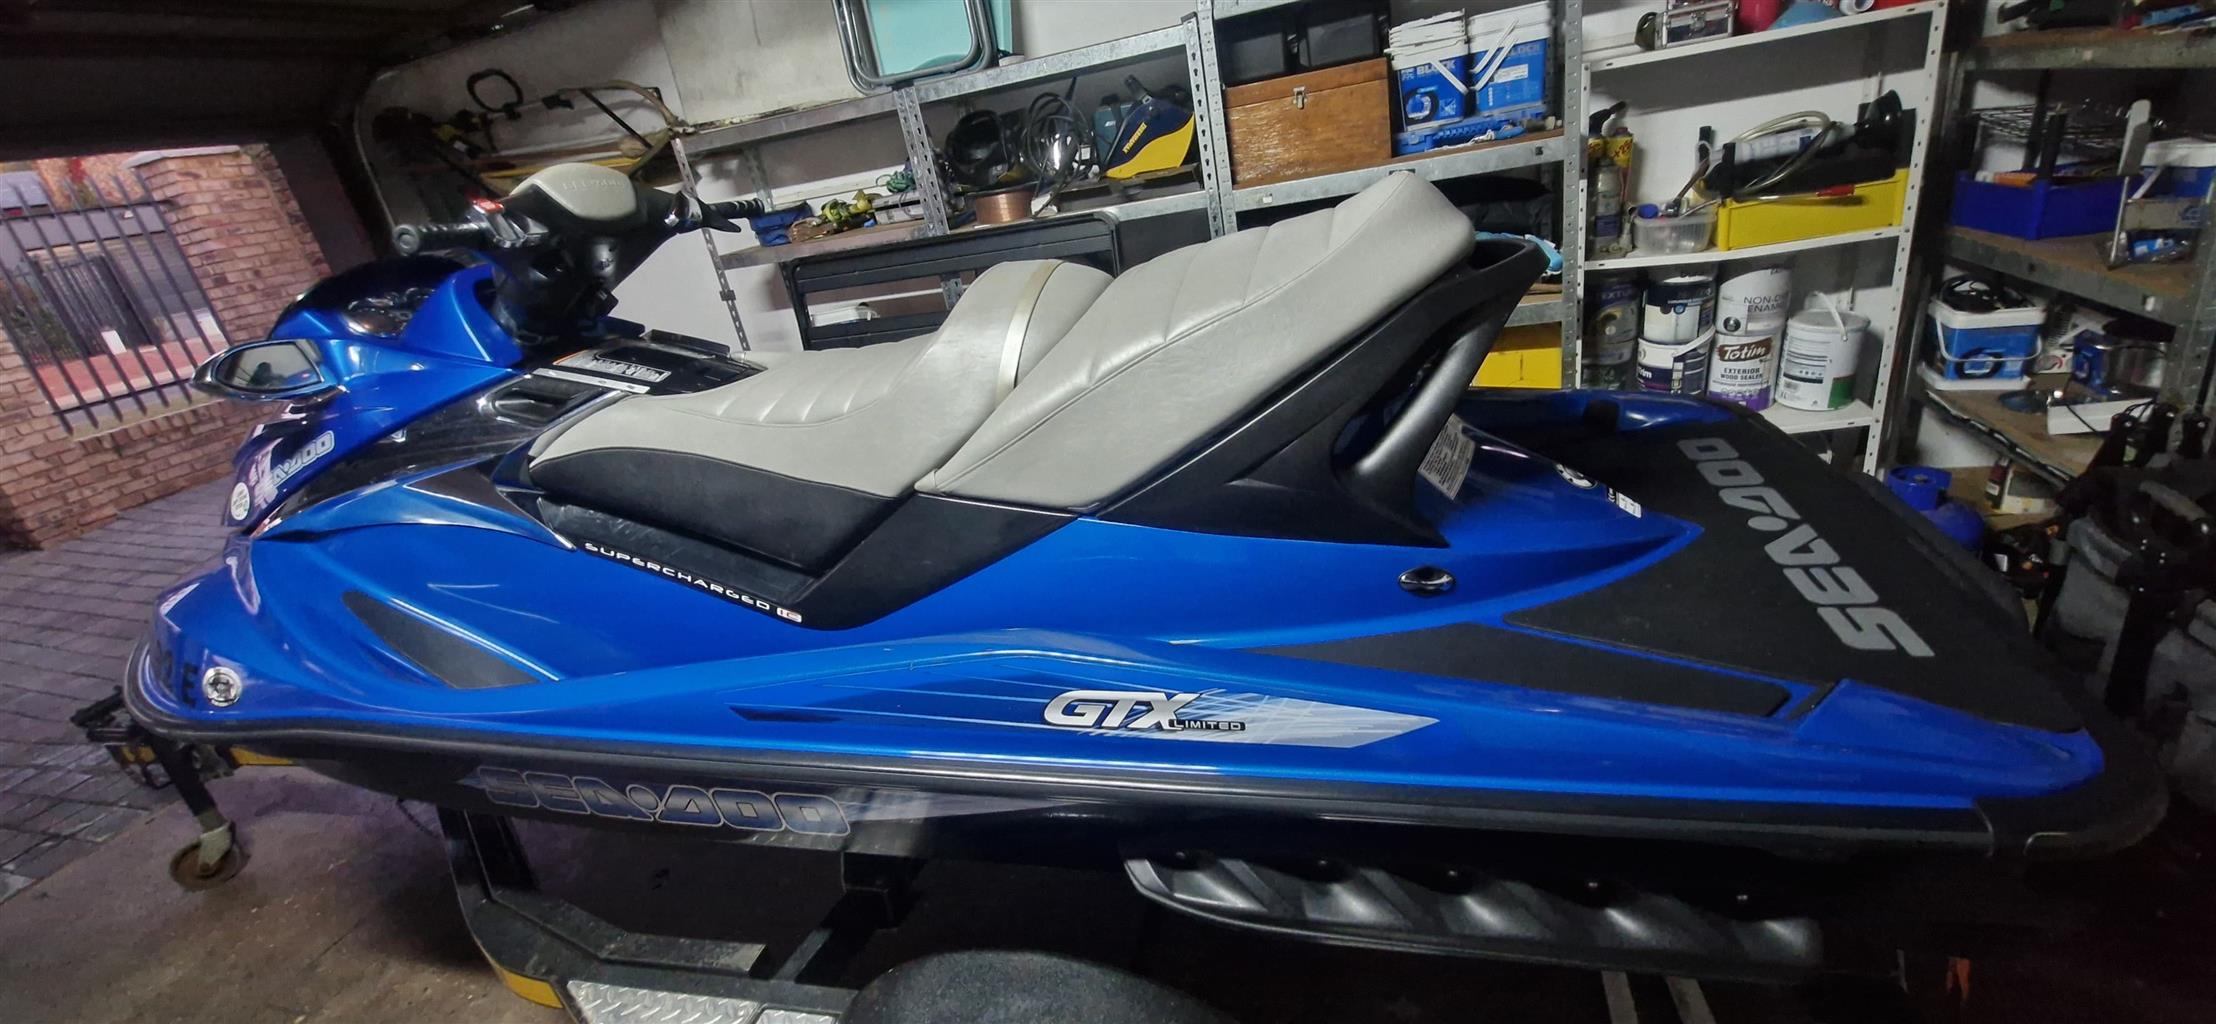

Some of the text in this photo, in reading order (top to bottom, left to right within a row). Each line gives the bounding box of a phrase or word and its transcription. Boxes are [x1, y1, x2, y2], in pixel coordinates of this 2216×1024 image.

[1724, 344, 1766, 360] Totim
[1723, 367, 1760, 375] EXTERIOR
[585, 542, 770, 611] SUPERCHARGED
[1044, 689, 1243, 731] GTX LIMITED
